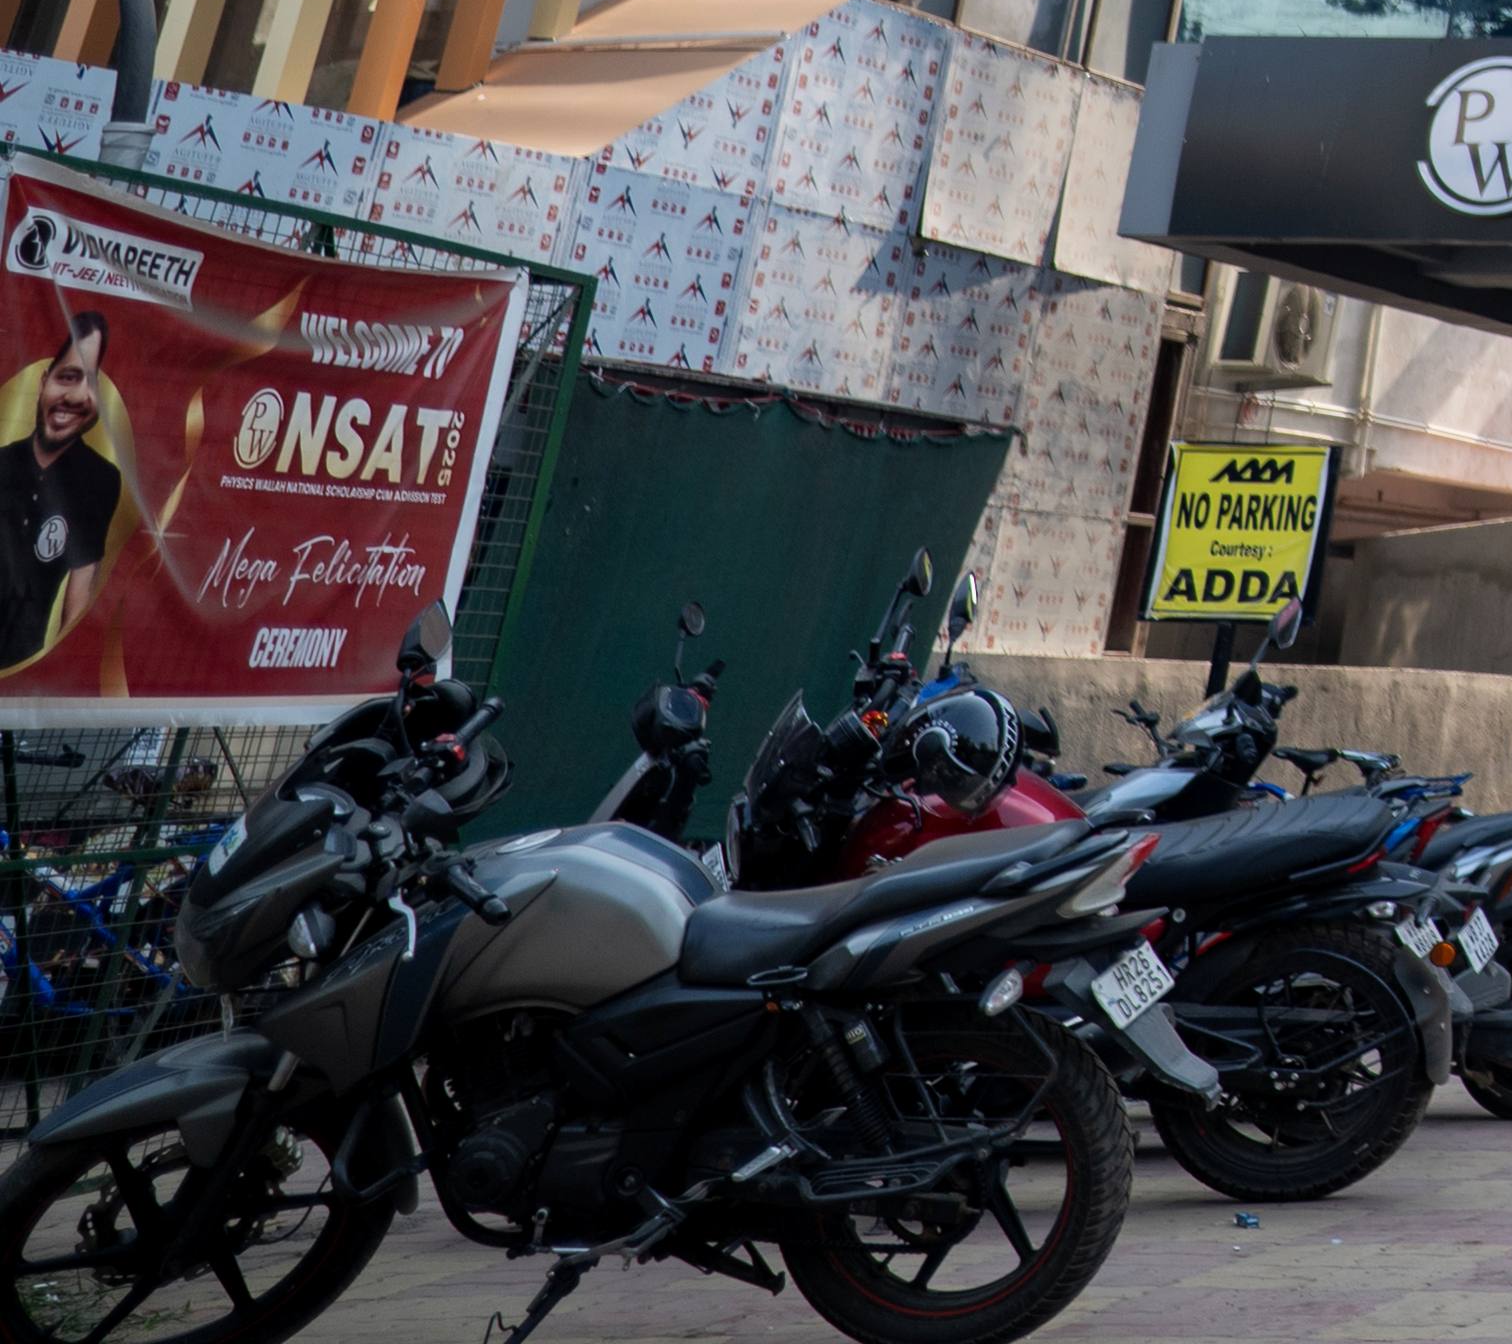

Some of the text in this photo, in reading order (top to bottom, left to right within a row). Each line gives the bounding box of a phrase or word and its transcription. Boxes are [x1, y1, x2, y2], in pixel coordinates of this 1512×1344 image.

[52, 260, 100, 284] IIT-JEE
[61, 222, 197, 288] VIDYAPEETH
[299, 311, 466, 381] WELCOME TO
[275, 391, 454, 486] NSAT
[437, 410, 466, 488] 2025
[220, 474, 448, 505] PHYSICS WALLAH NATIONAL CUM TEST
[1175, 492, 1318, 533] NO PARKING
[196, 527, 427, 609] Mega Felicitation
[1210, 540, 1265, 559] Courtesy
[1162, 569, 1302, 605] ADDA
[247, 628, 348, 669] CEREMONY
[1112, 950, 1151, 991] HR26
